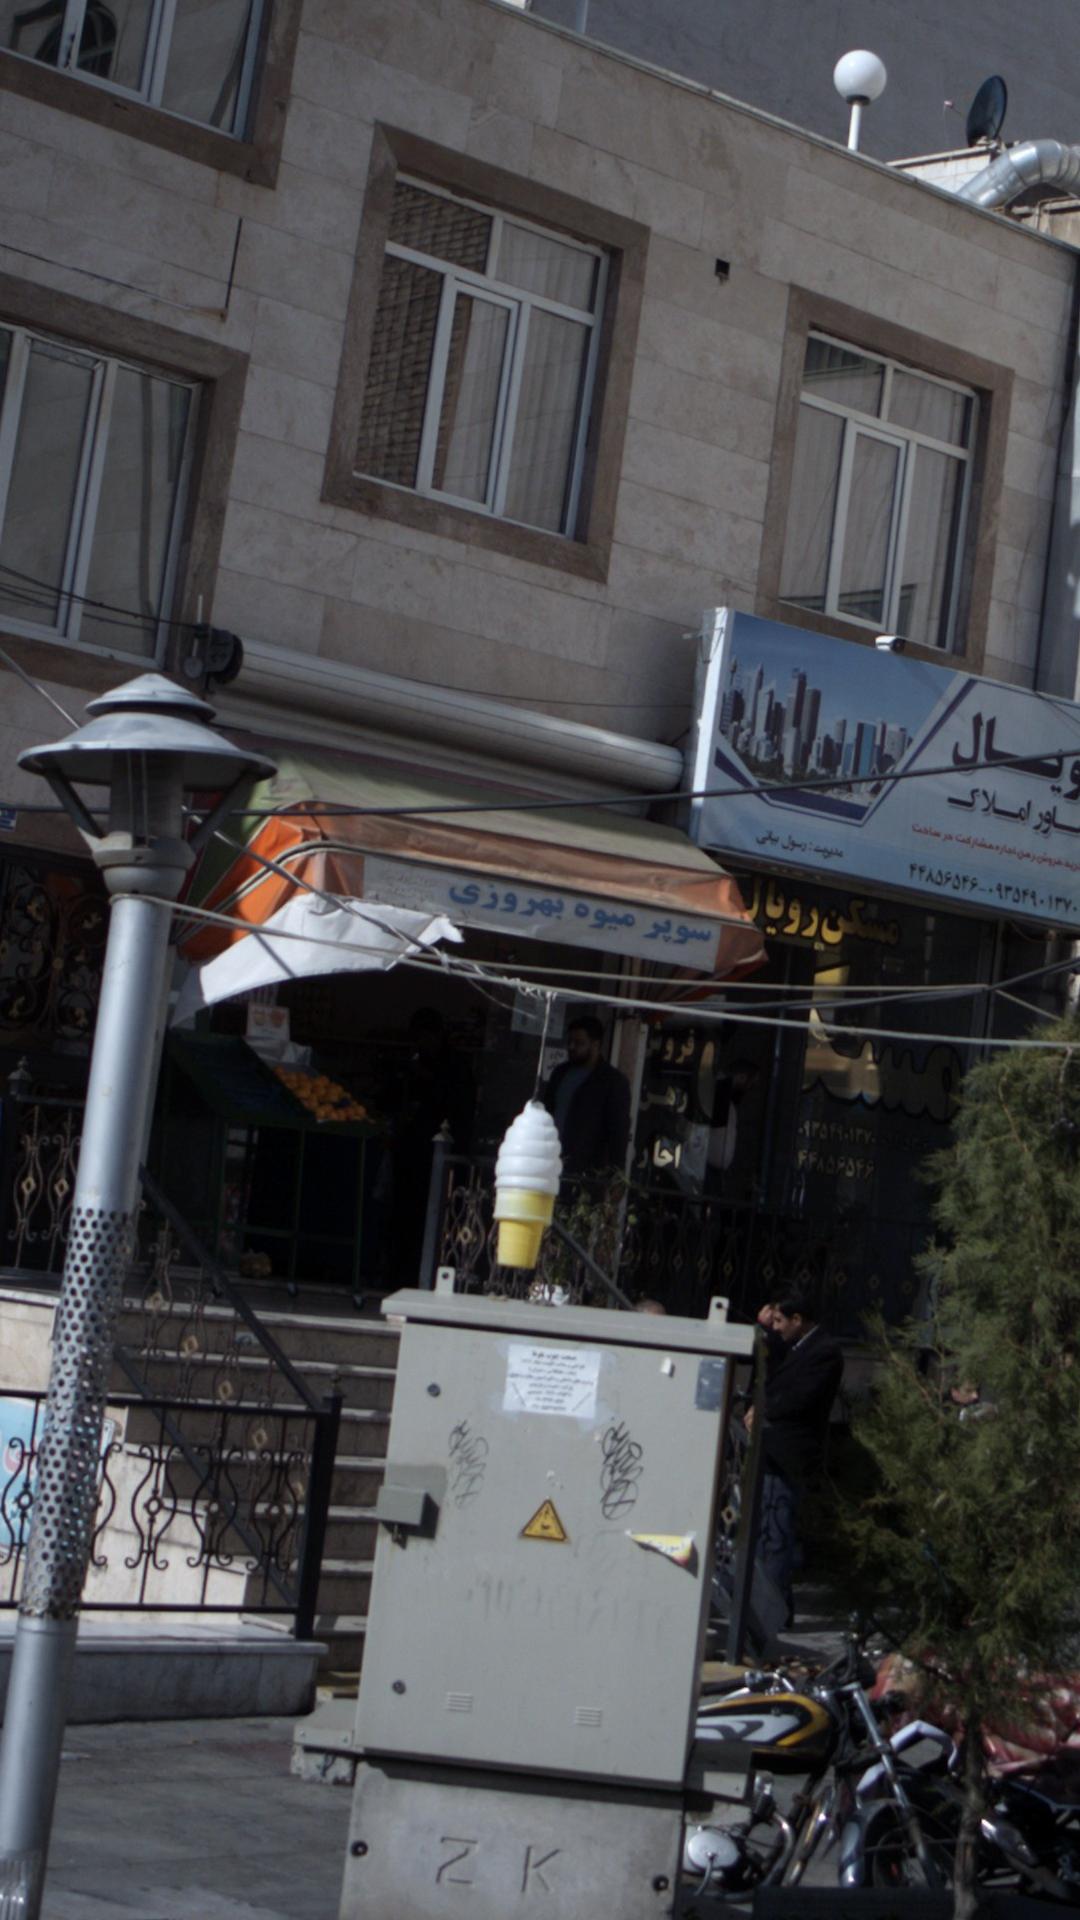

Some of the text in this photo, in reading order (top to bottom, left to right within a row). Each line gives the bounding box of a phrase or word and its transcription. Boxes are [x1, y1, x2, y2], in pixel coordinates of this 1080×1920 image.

[952, 712, 1080, 800] ویال
[911, 822, 941, 839] ساخت
[947, 788, 1031, 821] املاک
[449, 882, 712, 945] سوپر میوه بهروزی
[744, 877, 899, 946] مسکن رویال
